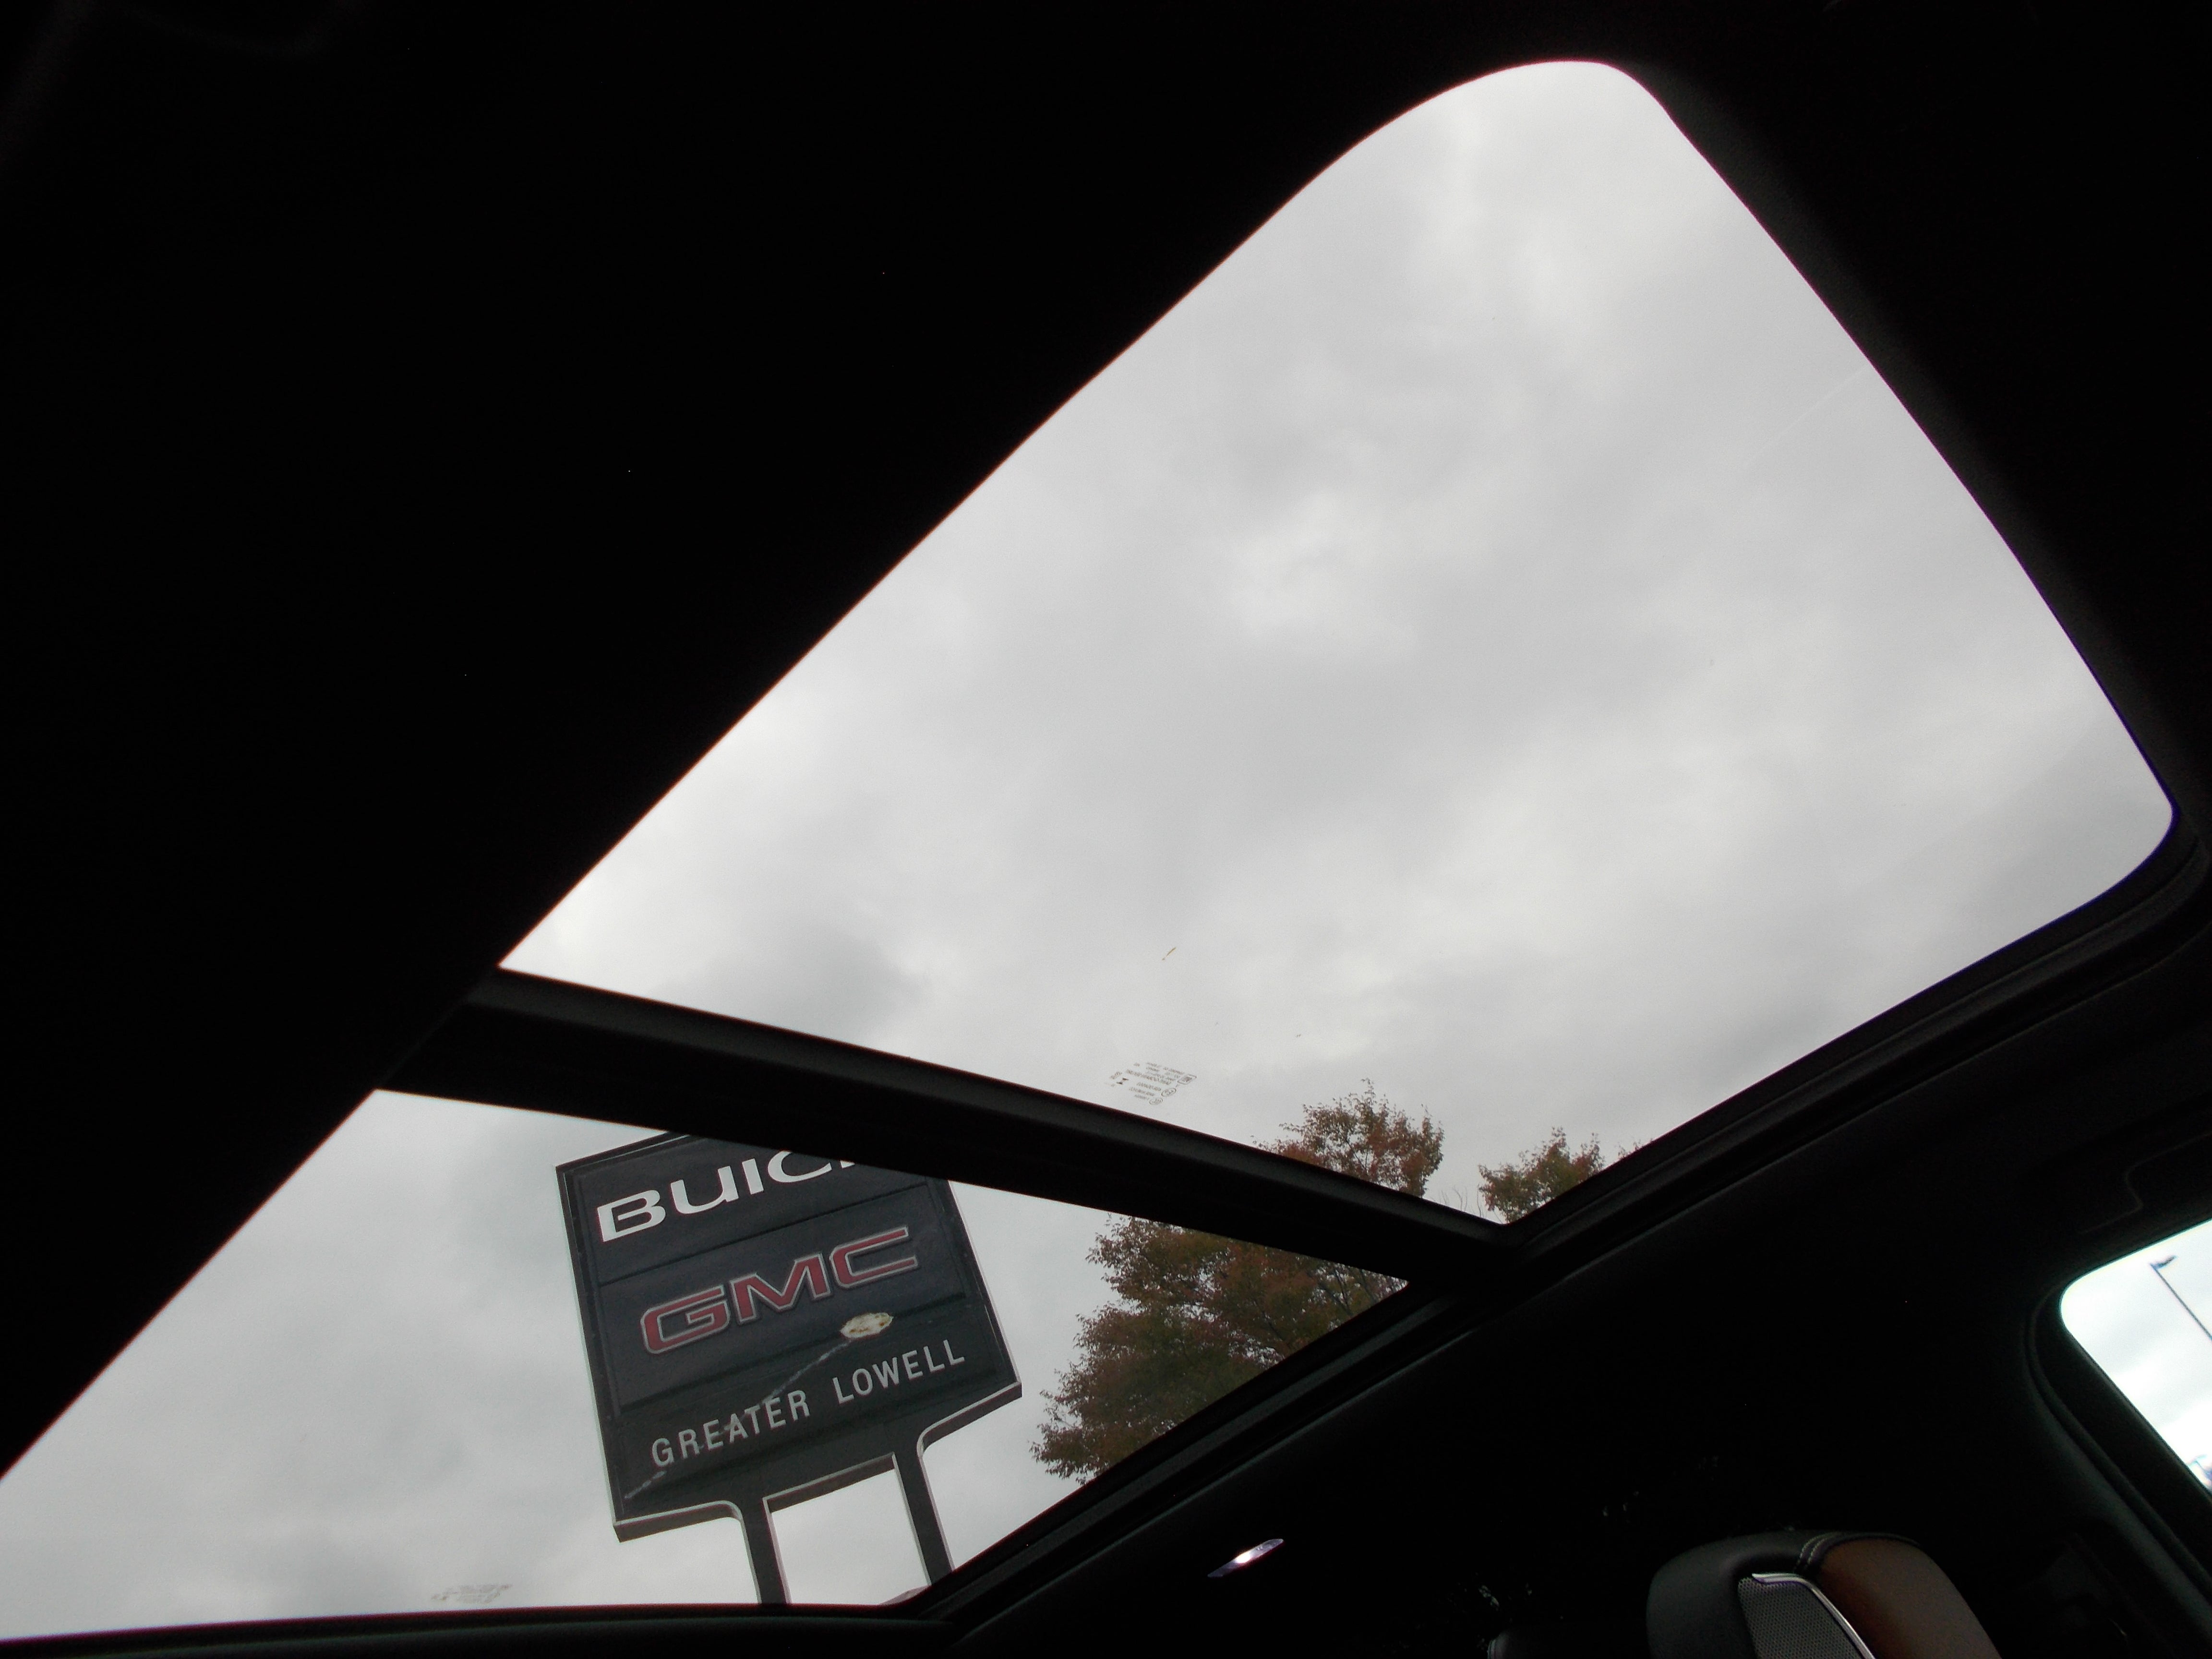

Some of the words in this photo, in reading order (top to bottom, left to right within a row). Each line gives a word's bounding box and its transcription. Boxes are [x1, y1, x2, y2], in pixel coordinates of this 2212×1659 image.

[597, 1150, 856, 1242] BUIC
[640, 1225, 918, 1354] GMC
[651, 1389, 811, 1468] GREATER
[832, 1339, 965, 1404] LOWELL
